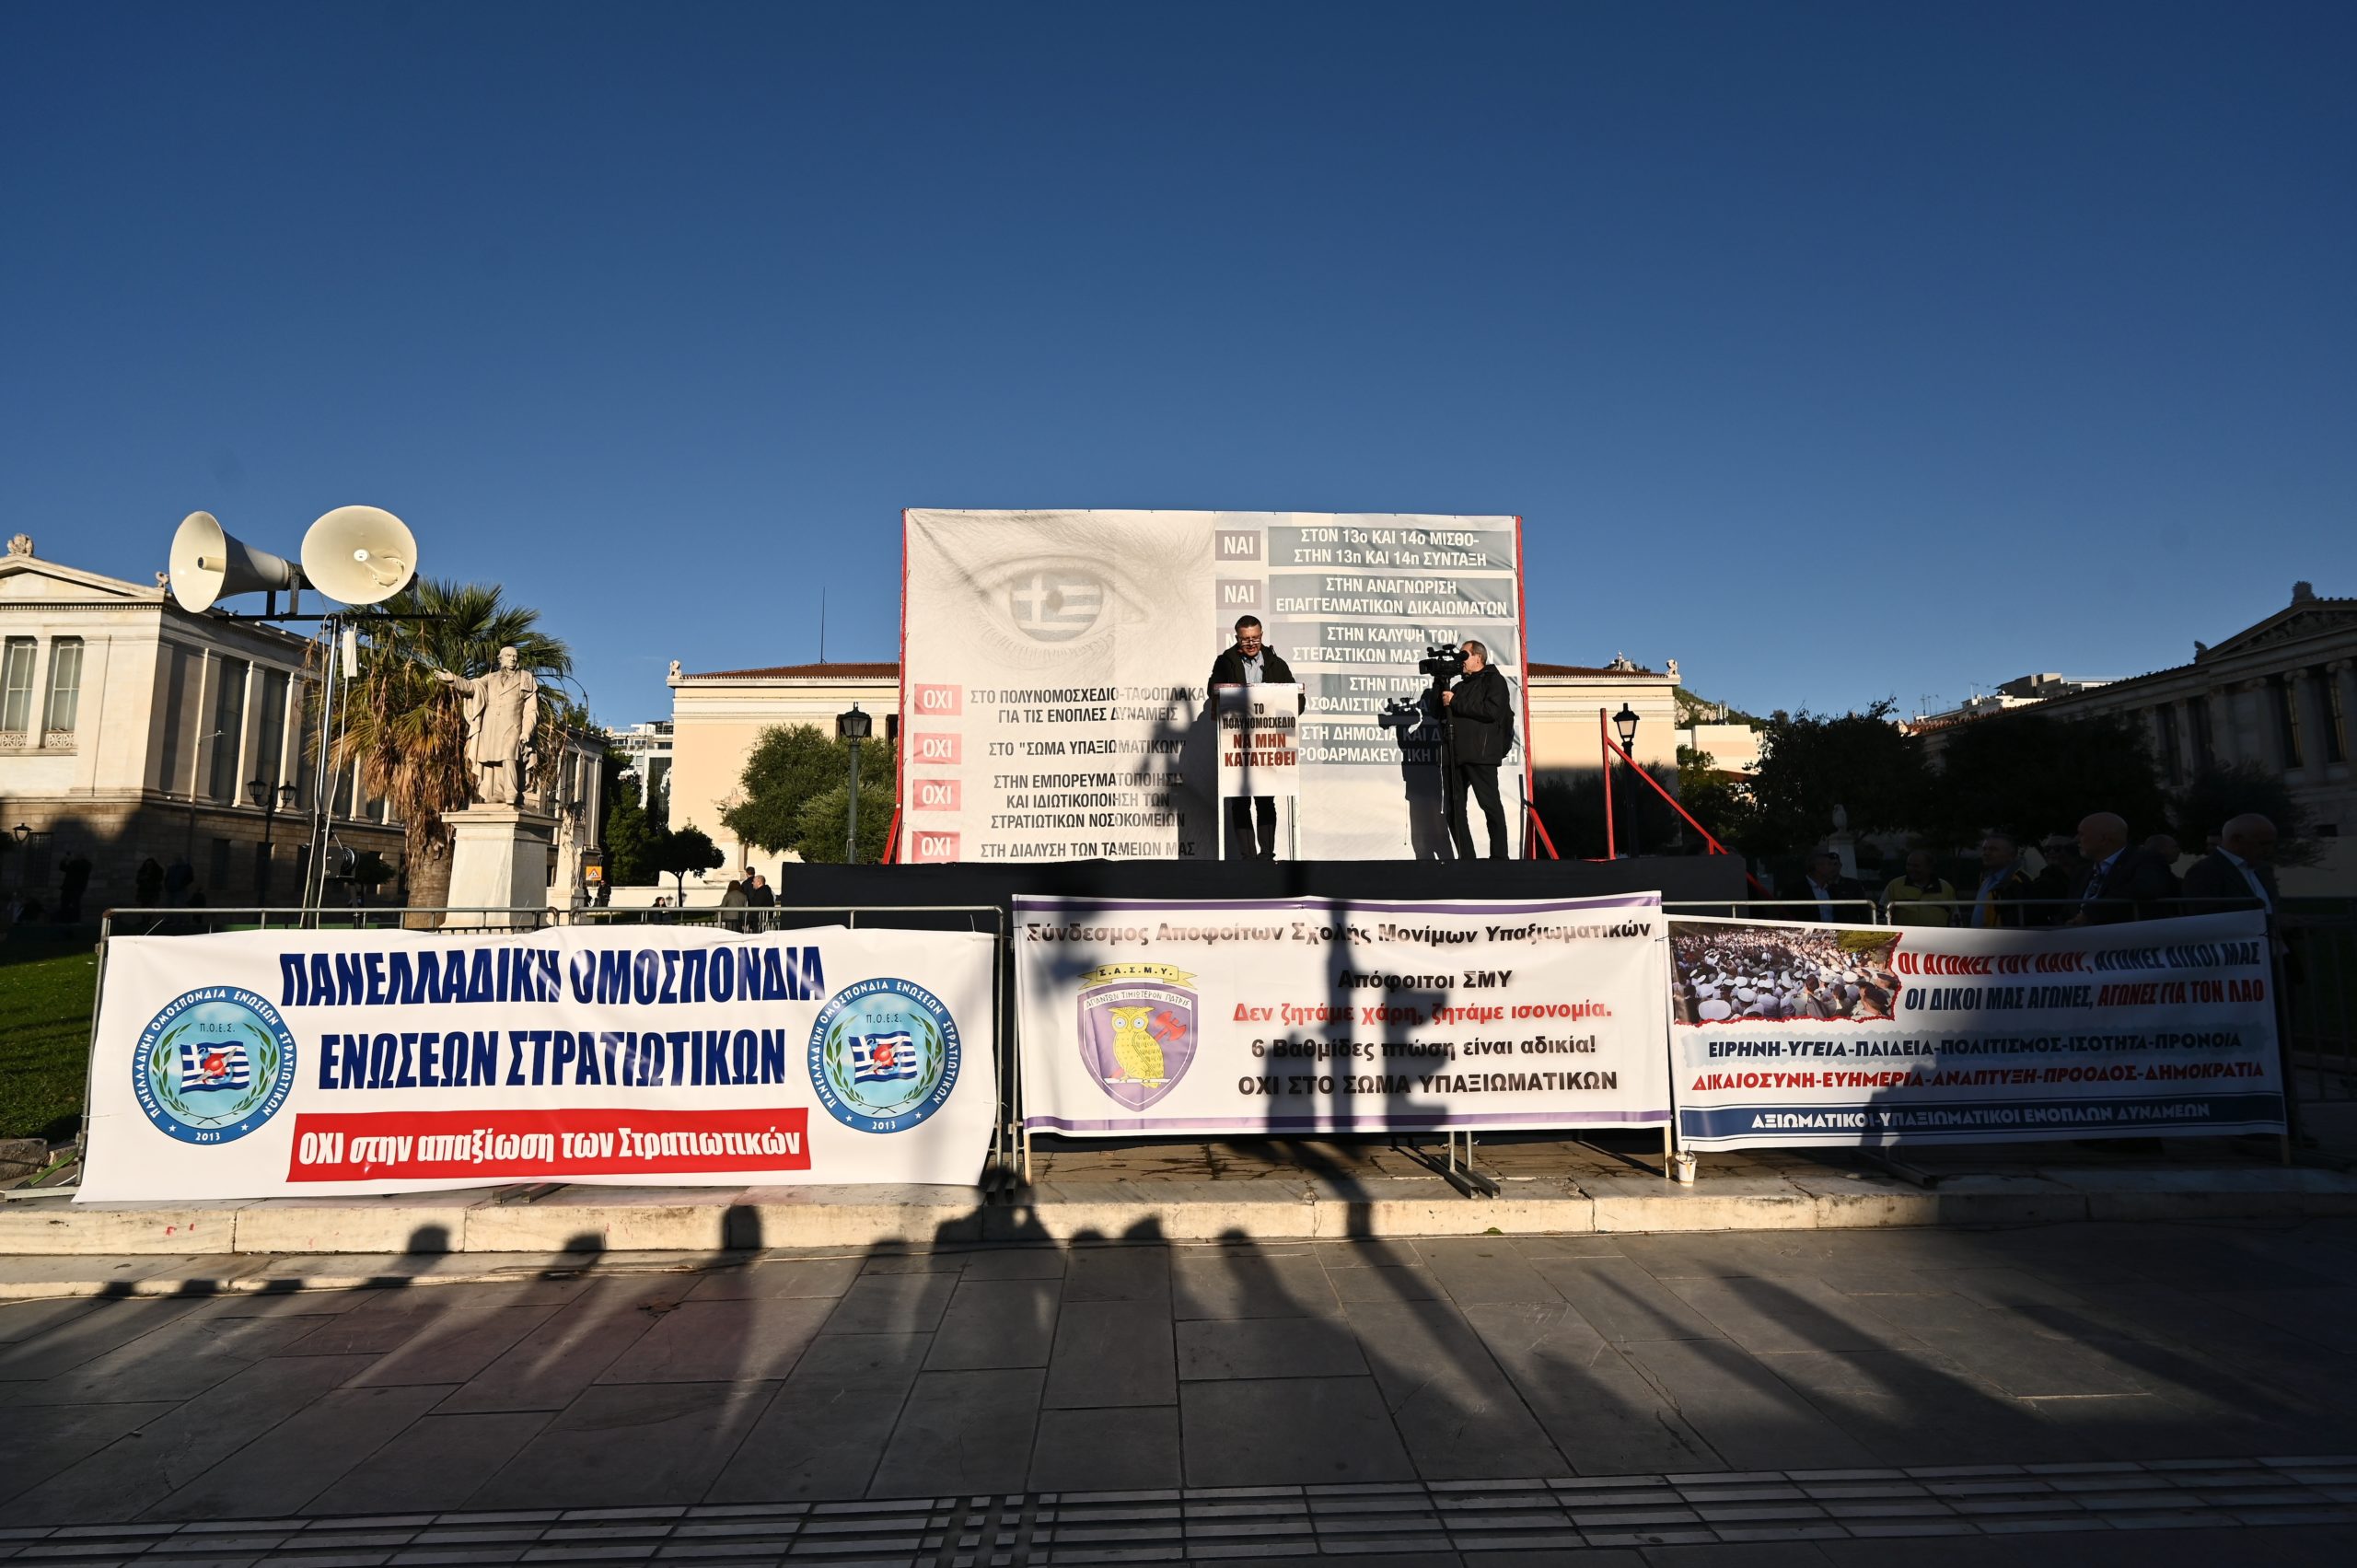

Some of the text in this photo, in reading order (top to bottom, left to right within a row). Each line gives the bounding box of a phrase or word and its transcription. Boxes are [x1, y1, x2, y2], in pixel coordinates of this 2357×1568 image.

[1224, 536, 1254, 554] ΝΑΙ
[1300, 528, 1338, 542] ΣΤΟΝ
[1372, 529, 1396, 544] ΚΑΙ
[1430, 531, 1480, 547] ΜΙΣΘΟ-
[1294, 549, 1331, 563] ΣΤΗΝ
[1365, 550, 1389, 564] ΚΑΙ
[1423, 551, 1487, 567] ΣΥΝΤΑΞΗ
[1225, 585, 1254, 604] ΝΑΙ
[1326, 577, 1457, 595] ΣΤΗΝ ΑΝΑΓΝΩΡΙΣΗ
[1276, 598, 1507, 615] ΕΠΑΓΓΕΛΜΑΤΙΚΩΝ ΔΙΚΑΙΩΜΑΤΩΝ
[1327, 626, 1458, 644] ΣΤΗΝ ΚΑΛΥΨΗ ΤΩΝ
[1292, 646, 1421, 664] ΣΤΕΓΑΣΤΙΚΩΝ ΜΑΣ
[1350, 677, 1387, 691] ΣΤΗΝ
[923, 690, 953, 709] ΟΧΙ
[970, 687, 1206, 703] ΣΤΟ ΠΟΛΥΝΟΜΟΣΧΕΔΙΟ-ΤΑΦΟΠΛΑΚΑ
[998, 706, 1178, 724] ΓΙΑ ΤΙΣ ΕΝΟΠΛΕΣ ΔΥΝΑΜΕΙΣ
[1253, 703, 1264, 714] ΤΟ
[1223, 716, 1296, 729] ΠΟΛΥΝΟΜΟΣΧΕΔΙΟ
[1233, 733, 1286, 749] ΝΑ ΜΗΝ
[1301, 726, 1329, 741] ΣΤΗ
[1333, 726, 1397, 742] ΔΗΜΟΣΙΑ
[923, 738, 952, 758] ΟΧΙ
[989, 739, 1186, 757] ΣΤΟ "ΣΩΜΑ ΥΠΑΞΙΩΜΑΤΙΚΩΝ"
[1225, 750, 1295, 767] ΚΑΤΑΤΕΘΕΙ
[993, 772, 1184, 789] ΣΤΗΝ ΕΜΠΟΡΕΥΜΑΤΟΠΟΙΗΣΗ
[922, 784, 951, 805] ΟΧΙ
[1006, 793, 1170, 809] ΚΑΙ ΙΔΙΩΤΙΚΟΠΟΙΗΣΗ ΤΩΝ
[991, 812, 1186, 829] ΣΤΡΑΤΙΩΤΙΚΩΝ ΝΟΣΟΚΟΜΕΙΩΝ
[921, 837, 950, 856] ΟΧΙ
[981, 842, 1196, 858] ΣΤΗ ΔΙΑΛΥΣΗ ΤΩΝ ΤΑΜΕΙΩΝ ΜΑΣ
[1027, 920, 1652, 947] Σύνδεσμος Αποφοίτων Σχολής Μονίμων Υπαξιωματικών
[1898, 941, 2261, 975] ΟΙ ΑΓΩΝΕΣ ΤΟΥ ΛΑΟΥ, ΑΓΩΝΕΣ ΔΙΚΟΙ ΜΑΣ
[279, 946, 826, 1006] ΠΑΝΕΛΛΑΔΙΚΗ ΟΜΟΣΠΟΝΔΙΑ
[1098, 967, 1173, 977] Σ.Α.Σ.Μ.Υ.
[1338, 970, 1513, 993] Απόφοιτοι ΣΜΥ
[1905, 979, 2264, 1011] ΟΙ ΔΙΚΟΙ ΜΑΣ ΑΓΩΝΕΣ, ΑΓΩΝΕΣ ΓΙΑ ΤΟΝ ΛΑΟ
[866, 1014, 902, 1024] Π.Ο.Ε.Σ.
[1233, 999, 1612, 1026] Δεν ζητάμε χάρη, ζητάμε ισονομία.
[200, 1023, 236, 1033] Π.Ο.Ε.Σ.
[135, 989, 294, 1119] ΠΑΝΕΛΛΑΔΙΚΗ ΟΜΟΣΠΟΝΔΙΑ ΕΝΩΣΕΩΝ ΣΤΡΑΤΙΩΤΙΚΩΝ
[810, 981, 958, 1109] ΠΑΝΕΛΛΑΔΙΚΗ ΟΜΟΣΠΟΝΔΙΑ ΕΝΩΣΕΩΝ ΣΤΡΑΤΙΩΤΙΚΩΝ
[1251, 1035, 1596, 1061] 6 Βαθμίδες πτώση είναι αδικία!
[319, 1028, 785, 1090] ΕΝΩΣΕΩΝ ΣΤΡΑΤΙΩΤΙΚΩΝ
[1238, 1071, 1618, 1096] ΟΧΙ ΣΤΟ ΣΩΜΑ ΥΠΑΞΙΩΜΑΤΙΚΩΝ
[2025, 1105, 2113, 1123] ΕΝΟΠΛΩΝ
[2118, 1103, 2210, 1121] ΔΥΝΑΜΕΩΝ
[872, 1121, 896, 1130] 2013
[195, 1132, 221, 1141] 2013
[298, 1126, 800, 1167] ΟΧΙ στην απαξίωση των Στρατιωτικών
